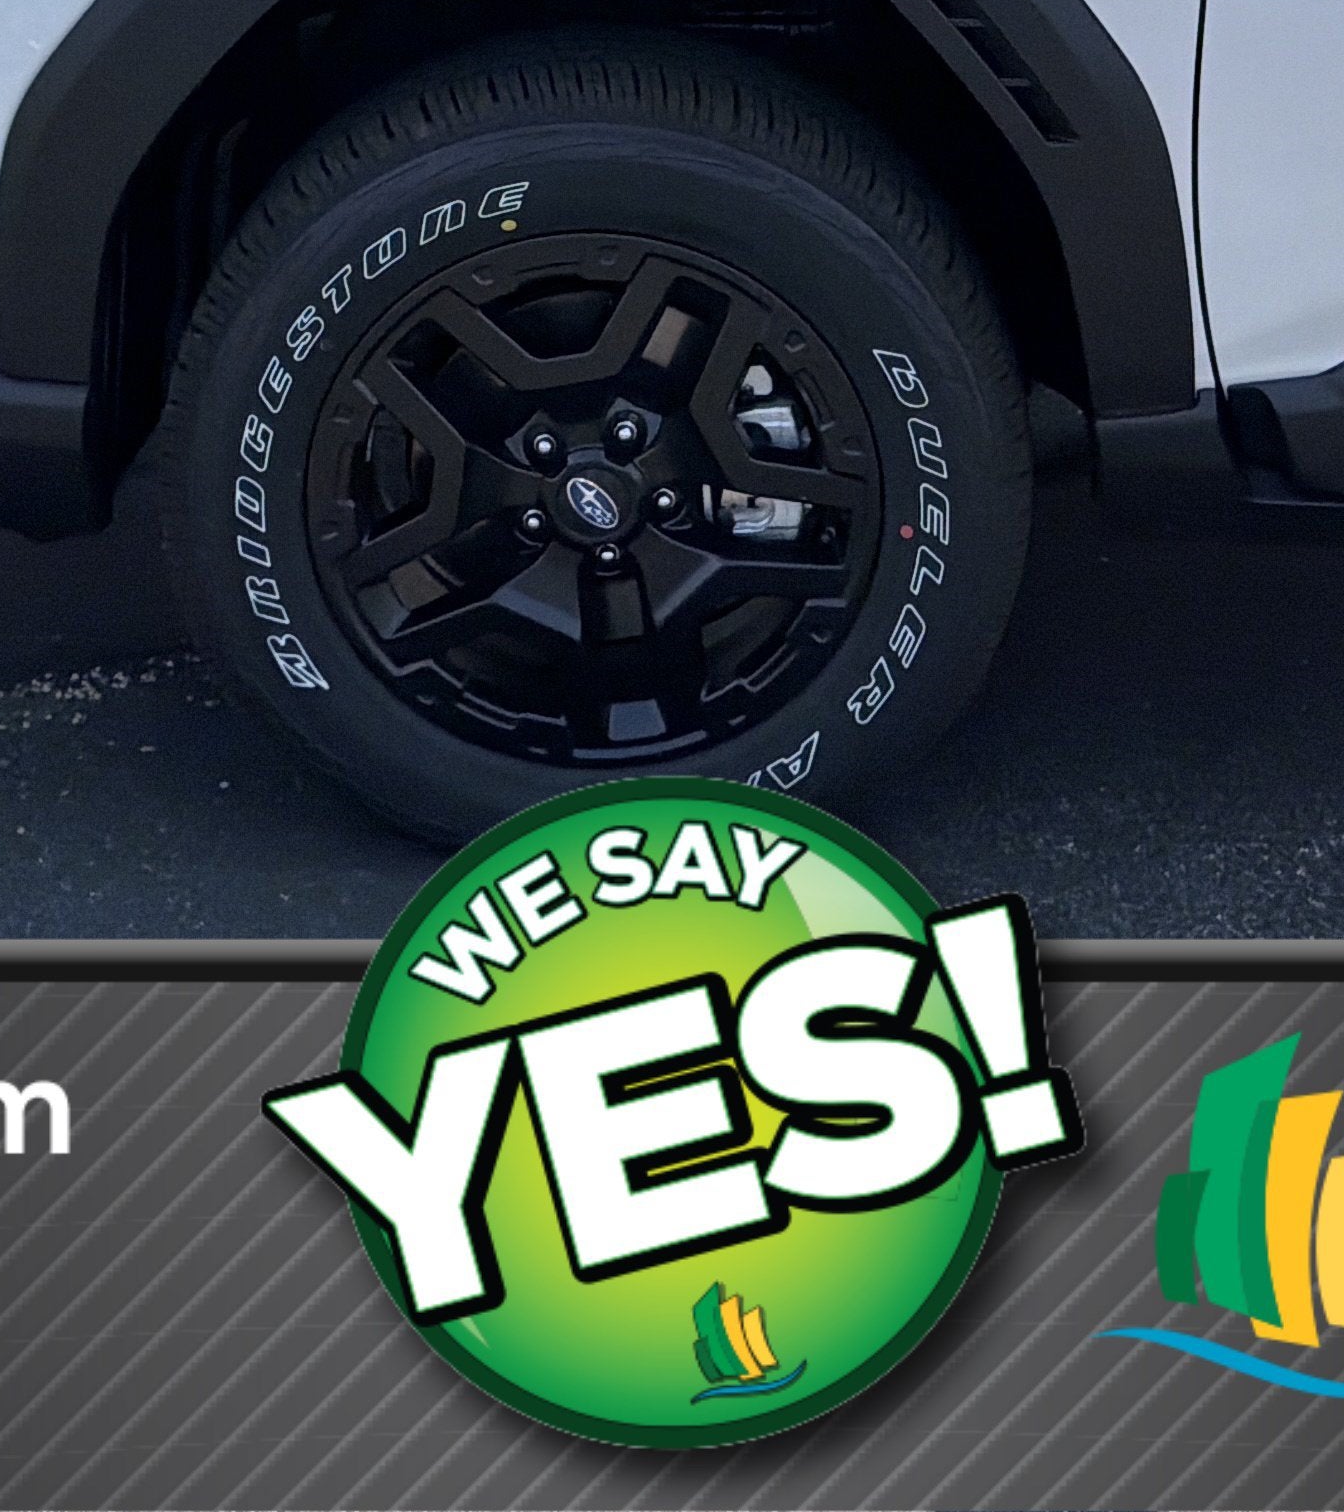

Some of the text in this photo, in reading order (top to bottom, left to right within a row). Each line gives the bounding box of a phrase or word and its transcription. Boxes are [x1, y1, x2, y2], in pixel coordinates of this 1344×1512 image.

[234, 180, 530, 691] BRIDGESTONE
[746, 348, 950, 790] DUELER A
